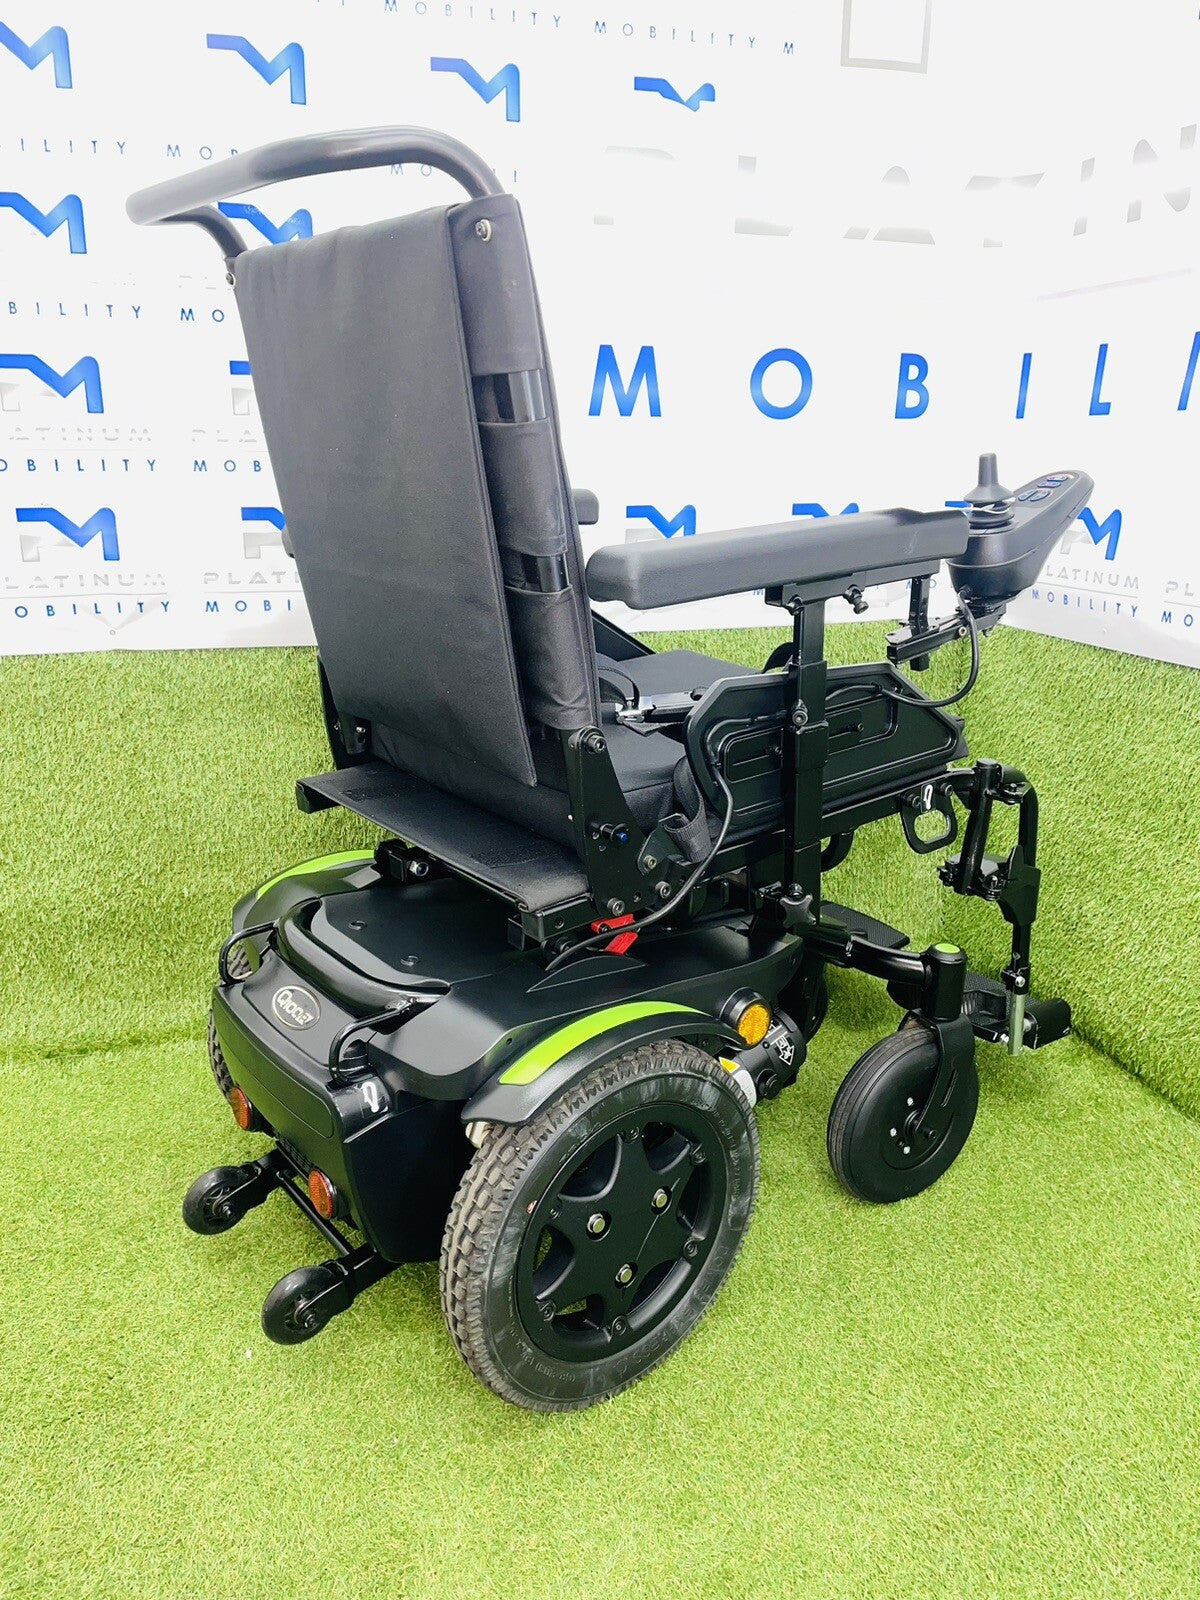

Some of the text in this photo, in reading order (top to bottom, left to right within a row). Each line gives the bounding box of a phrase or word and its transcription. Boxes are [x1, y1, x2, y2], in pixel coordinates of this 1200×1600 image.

[385, 0, 560, 27] MOBILITY
[595, 21, 755, 48] MOBILITY
[0, 138, 125, 154] ILITY
[8, 301, 224, 323] BILITY MO
[15, 601, 169, 618] OBILITY
[1031, 588, 1194, 628] MOBILITY MO
